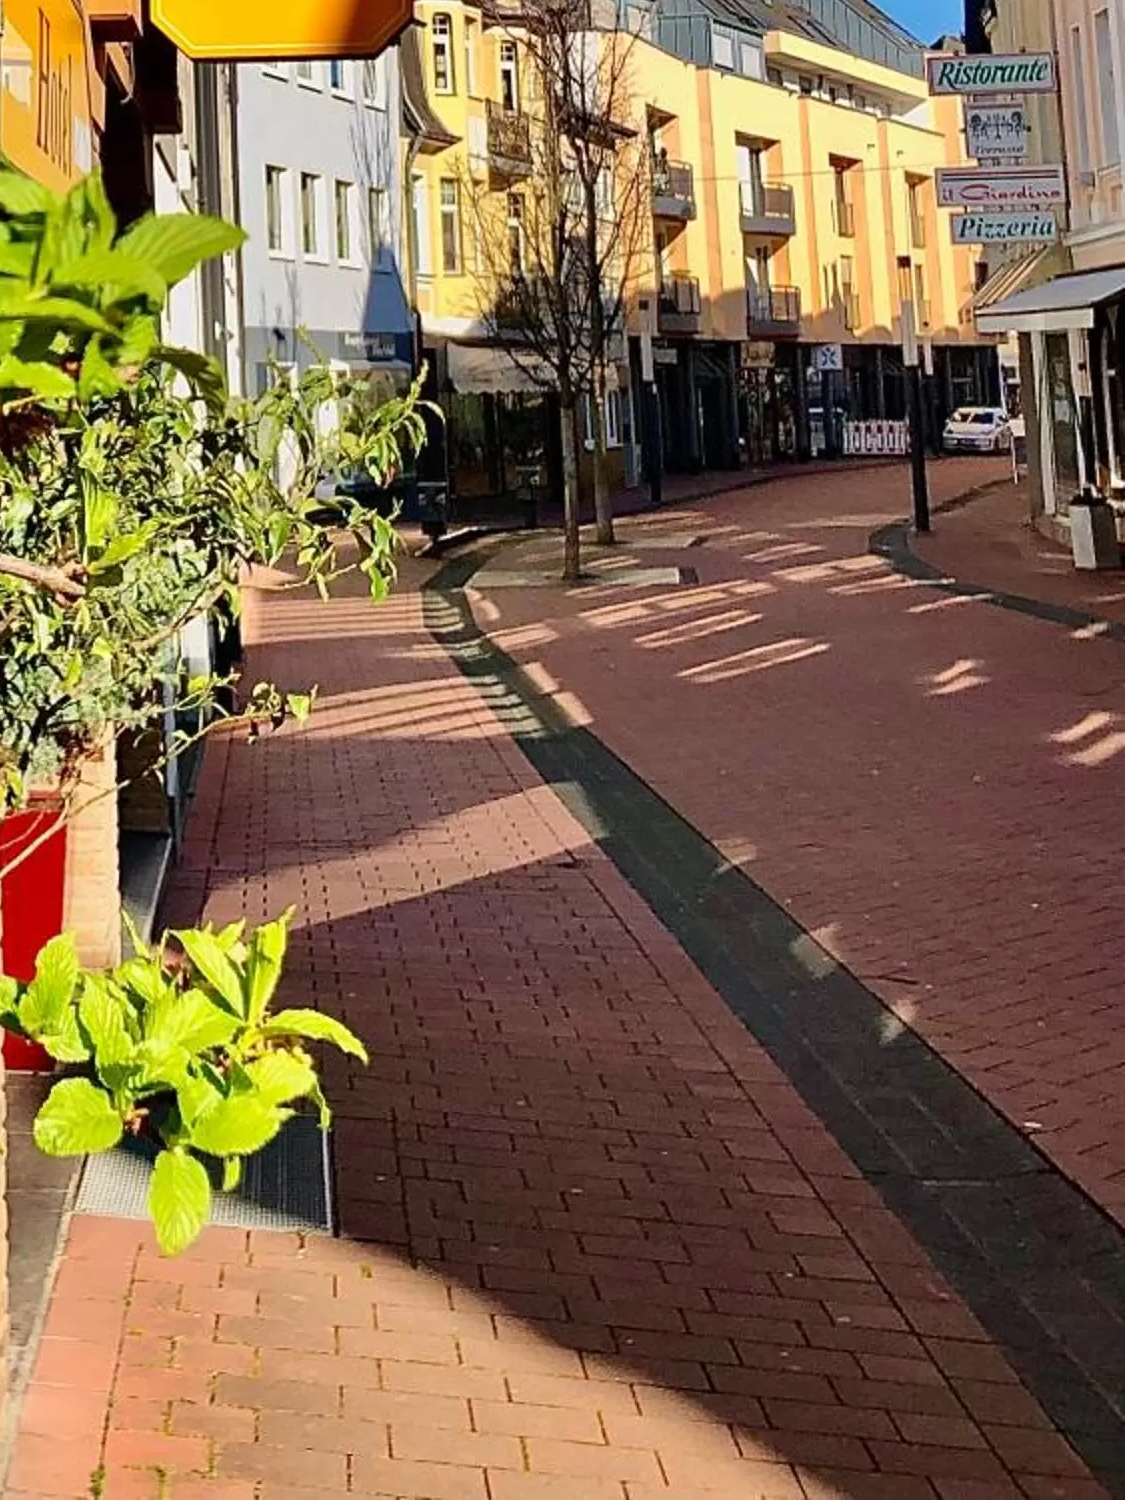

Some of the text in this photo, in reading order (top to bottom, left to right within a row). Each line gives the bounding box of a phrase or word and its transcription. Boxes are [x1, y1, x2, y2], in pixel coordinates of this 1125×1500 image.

[937, 60, 1048, 90] Ristorante
[35, 6, 73, 181] Hotel
[959, 184, 1060, 201] Giardino
[959, 215, 1053, 238] Pizzeria
